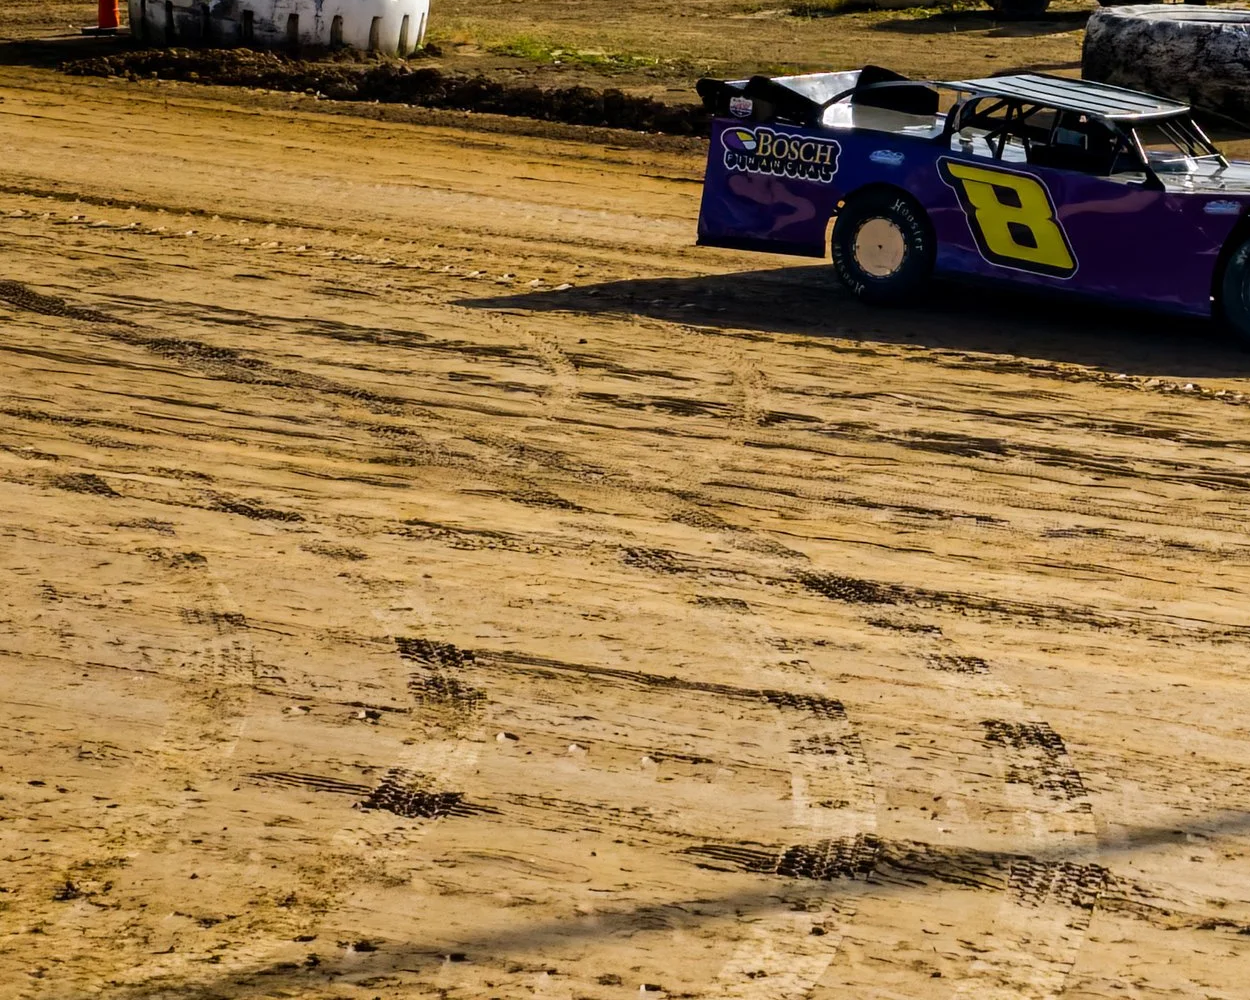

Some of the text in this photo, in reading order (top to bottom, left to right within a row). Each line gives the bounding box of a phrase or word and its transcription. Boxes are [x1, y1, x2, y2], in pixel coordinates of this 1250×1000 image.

[727, 153, 827, 175] FINANCIAL
[756, 132, 834, 166] BOSCH
[890, 199, 924, 251] Hoosier
[947, 162, 1073, 269] 8
